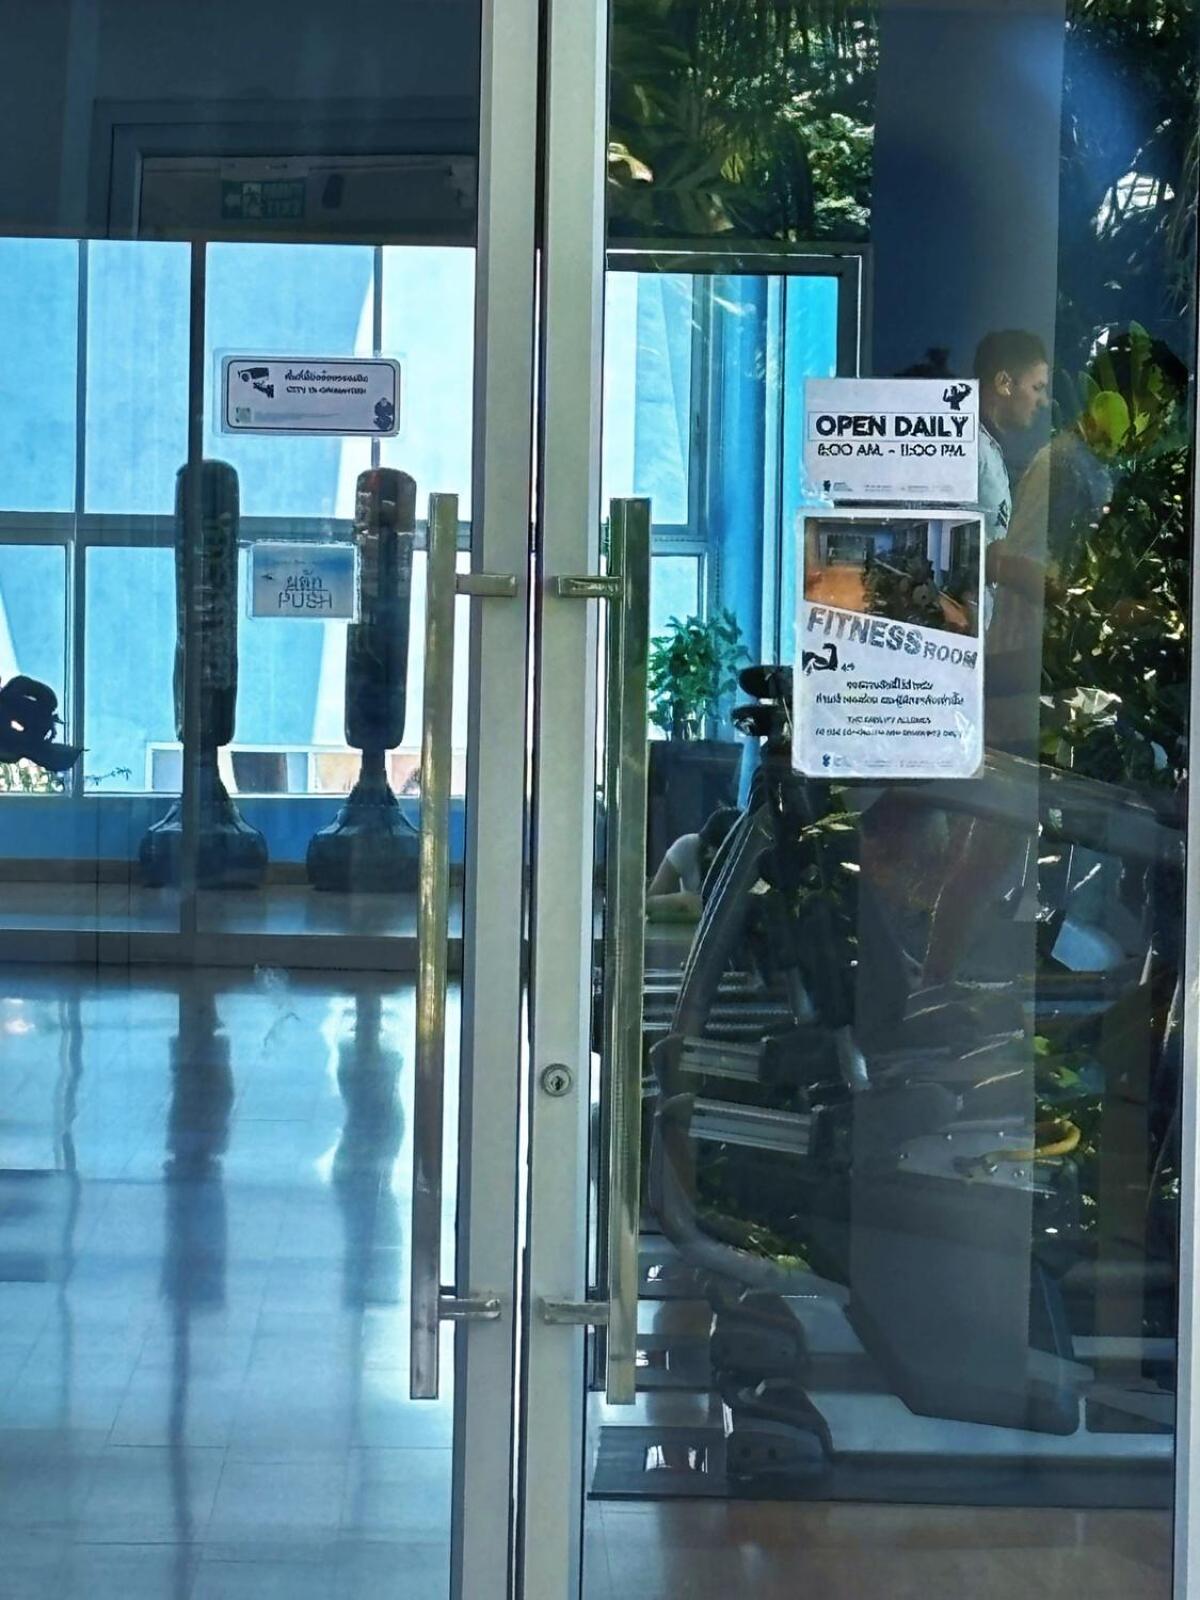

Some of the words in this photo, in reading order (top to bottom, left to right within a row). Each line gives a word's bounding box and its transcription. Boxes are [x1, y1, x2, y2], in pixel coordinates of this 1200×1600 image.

[816, 415, 887, 437] OPEN
[894, 416, 969, 438] DAILY
[278, 590, 333, 609] PUSH
[806, 606, 923, 656] FITNESS
[922, 641, 978, 670] ROOM
